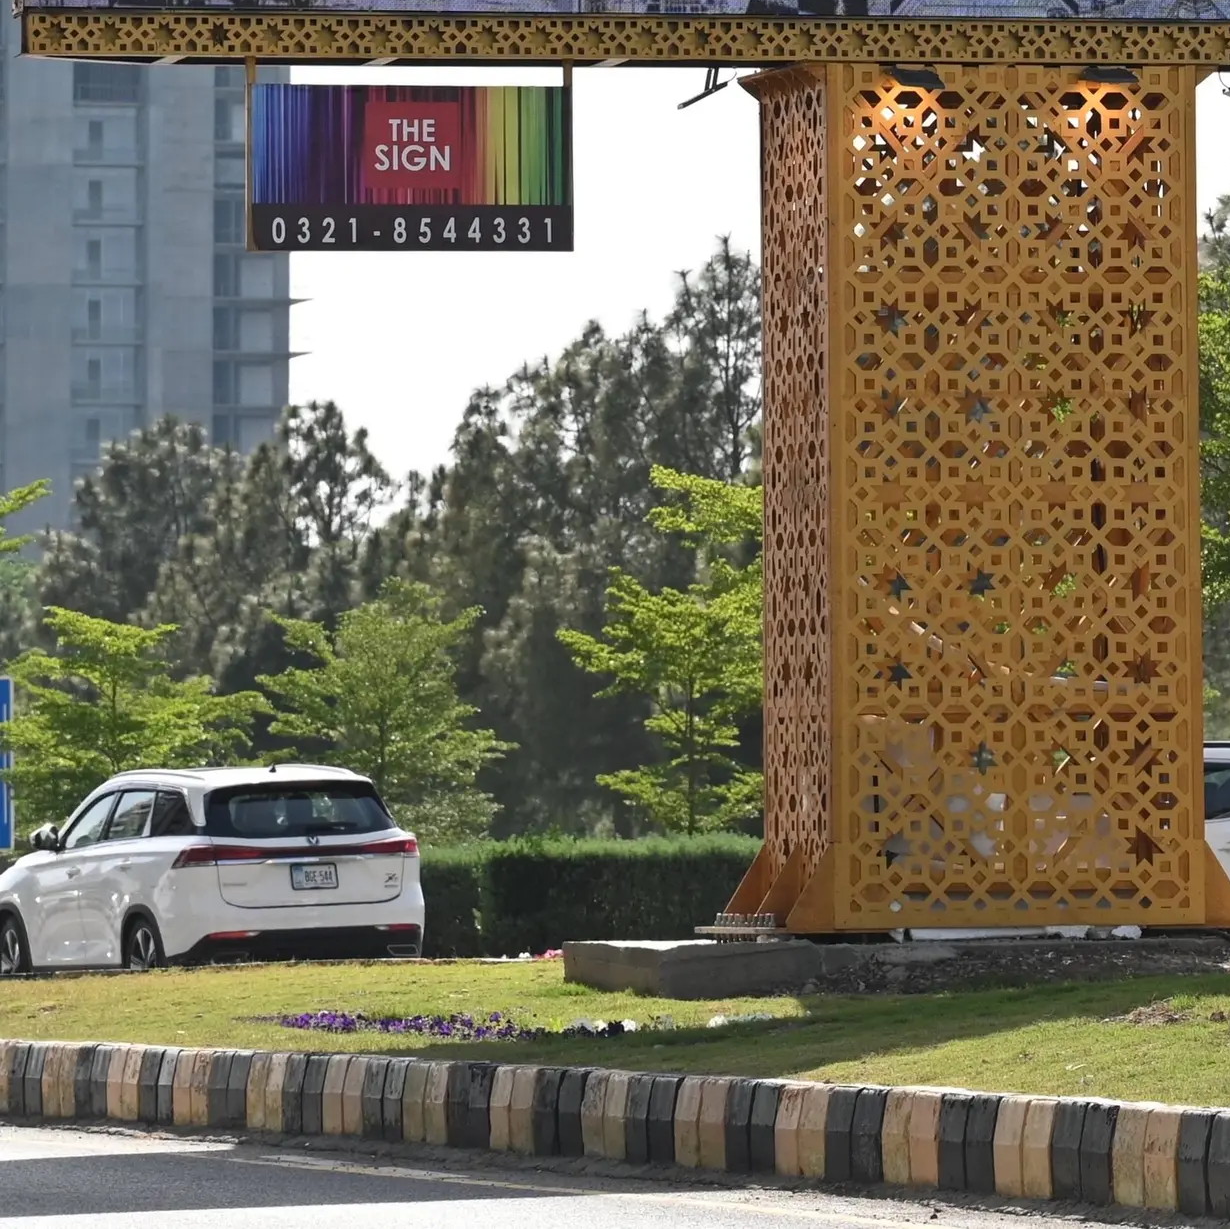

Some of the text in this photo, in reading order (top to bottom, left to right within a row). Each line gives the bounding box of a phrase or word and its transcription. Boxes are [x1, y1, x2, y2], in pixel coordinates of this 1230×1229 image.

[388, 118, 436, 142] THE
[374, 144, 451, 172] SIGN
[271, 216, 553, 244] 0321-8544331
